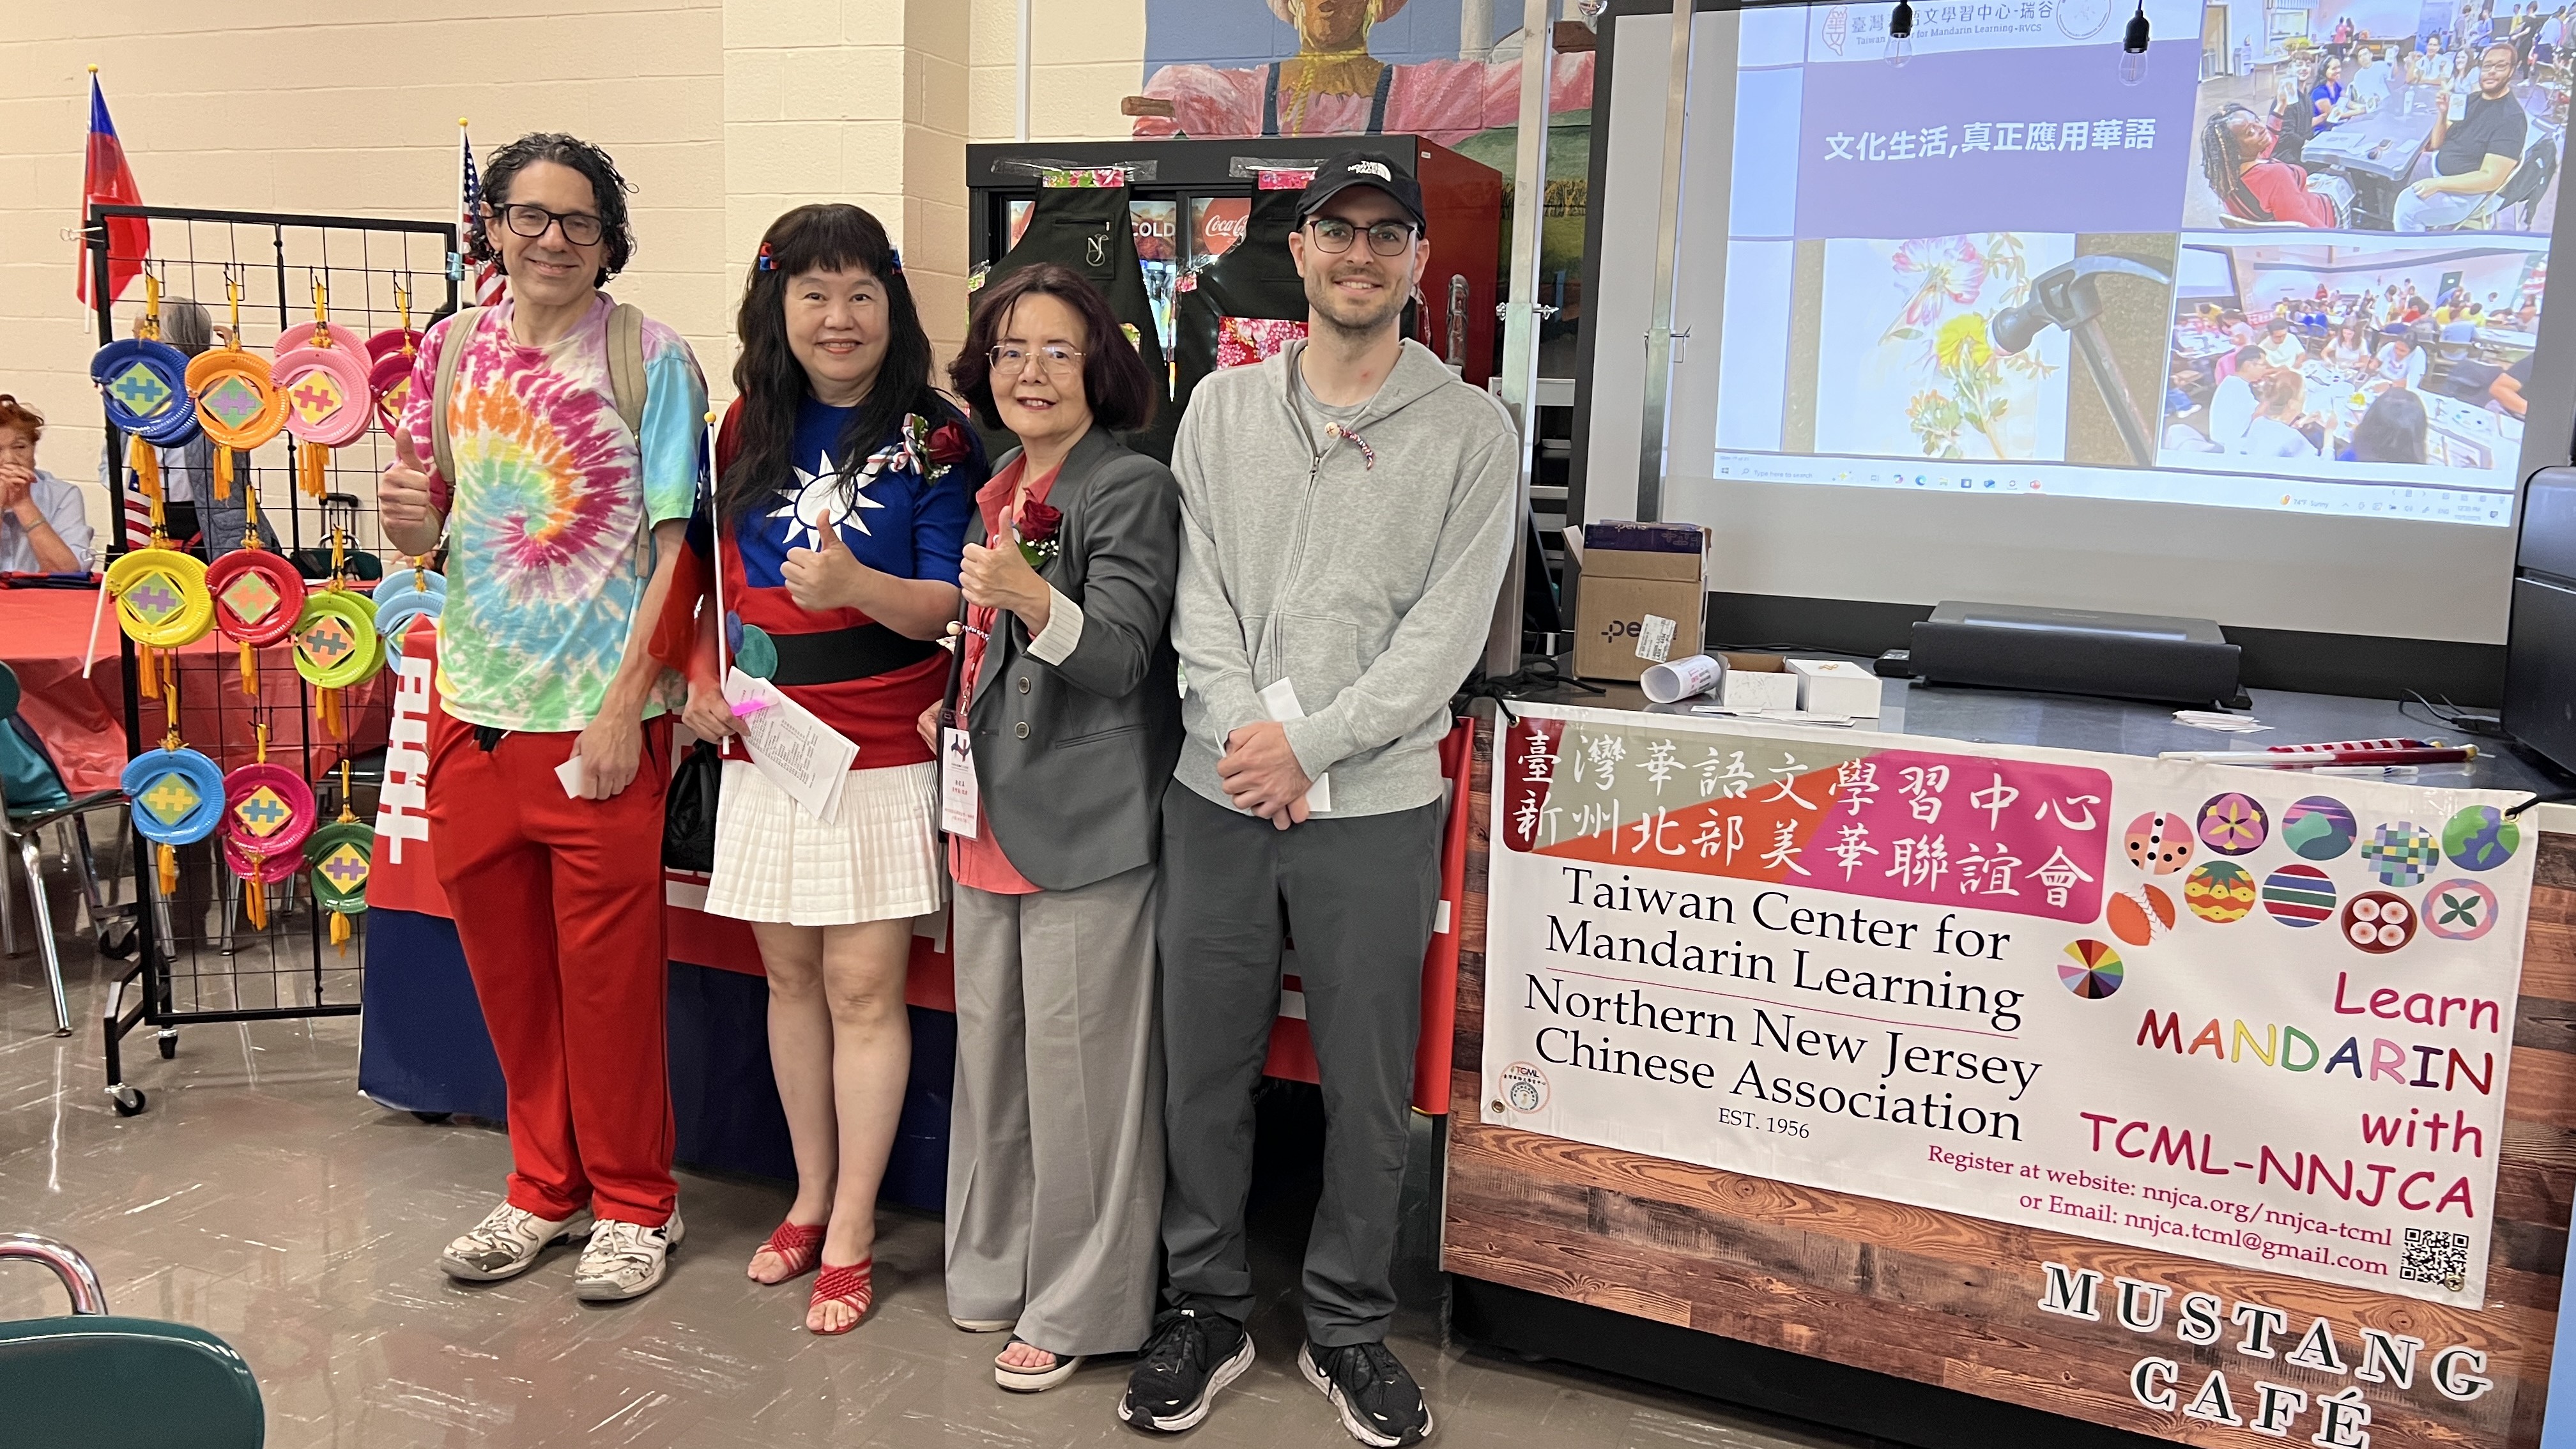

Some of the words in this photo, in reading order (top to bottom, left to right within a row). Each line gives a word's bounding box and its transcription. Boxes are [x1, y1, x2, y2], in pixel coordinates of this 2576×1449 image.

[1856, 36, 1886, 45] Taiwan
[1917, 29, 1929, 38] for
[1930, 26, 1972, 37] Mandarin
[1824, 118, 2156, 162] 文化生活,真正應用華語
[1517, 733, 2101, 832] 臺灣華語文學習中心
[1513, 789, 2094, 908] 新州北部美華聯誼會
[1562, 867, 1736, 924] Taiwan
[1752, 891, 1917, 951] Center
[1935, 915, 2011, 961] for
[1545, 915, 1777, 985] Mandarin
[1794, 950, 2024, 1032] Learning
[2334, 971, 2499, 1034] Learn
[1524, 974, 1736, 1043] Northern
[1752, 1009, 1868, 1064] New
[1881, 1031, 2043, 1101] Jersey
[1535, 1027, 1715, 1089] Chinese
[1729, 1060, 2023, 1142] Association
[2136, 1008, 2493, 1096] MANDARIN
[1719, 1107, 1760, 1131] EST.
[1767, 1117, 1810, 1140] 1956
[2080, 1112, 2474, 1219] TCML-NNJCA
[2361, 1107, 2483, 1158] with
[1928, 1145, 2014, 1177] Register
[2019, 1162, 2041, 1180] at
[2046, 1165, 2136, 1199] website:
[2142, 1184, 2392, 1247] nnjca.org/nnjca-tcml
[2020, 1195, 2043, 1209] or
[2049, 1195, 2119, 1225] Email:
[2124, 1212, 2389, 1276] nnjca.tcml@gmail.com
[2041, 1262, 2492, 1400] MUSTANG
[2131, 1357, 2370, 1448] CAFÉ
